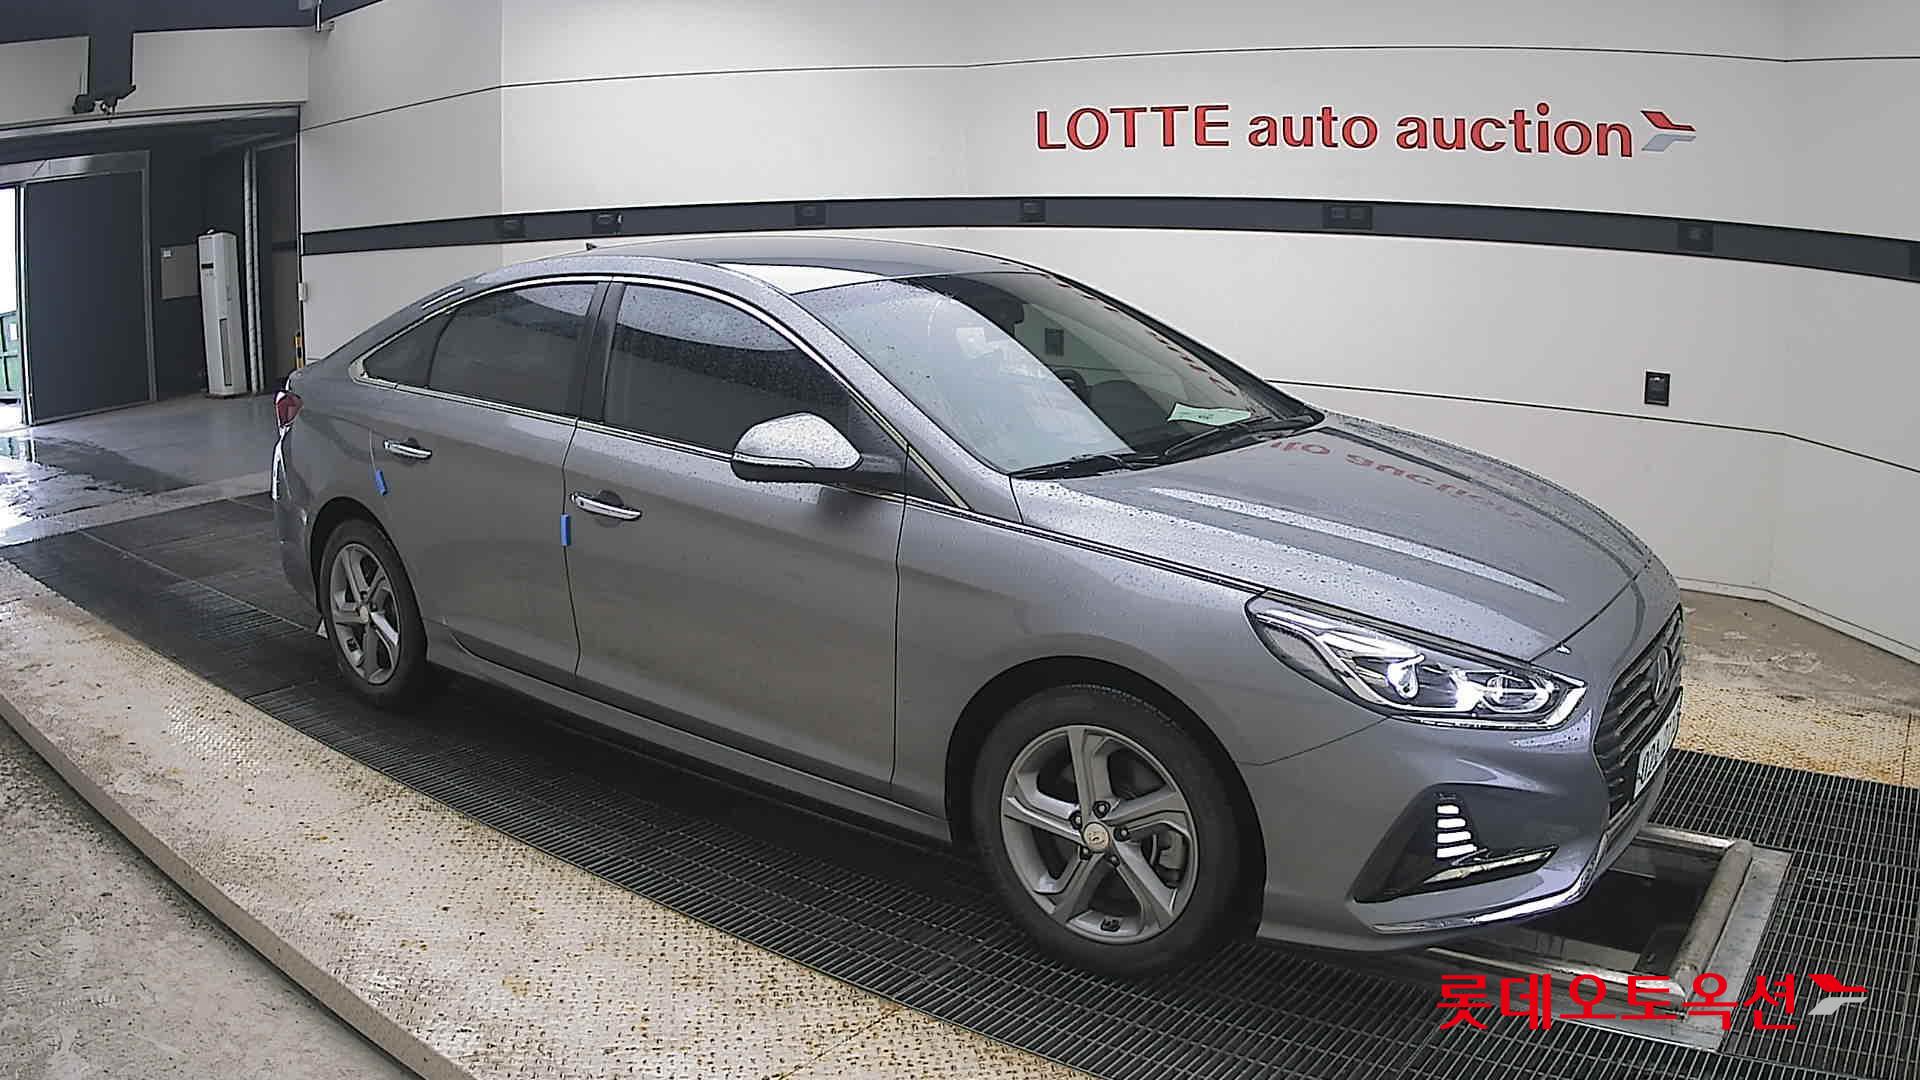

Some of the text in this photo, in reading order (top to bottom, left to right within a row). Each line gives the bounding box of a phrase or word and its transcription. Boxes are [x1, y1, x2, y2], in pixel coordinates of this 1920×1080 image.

[1037, 102, 1633, 157] LOTTE auto auction
